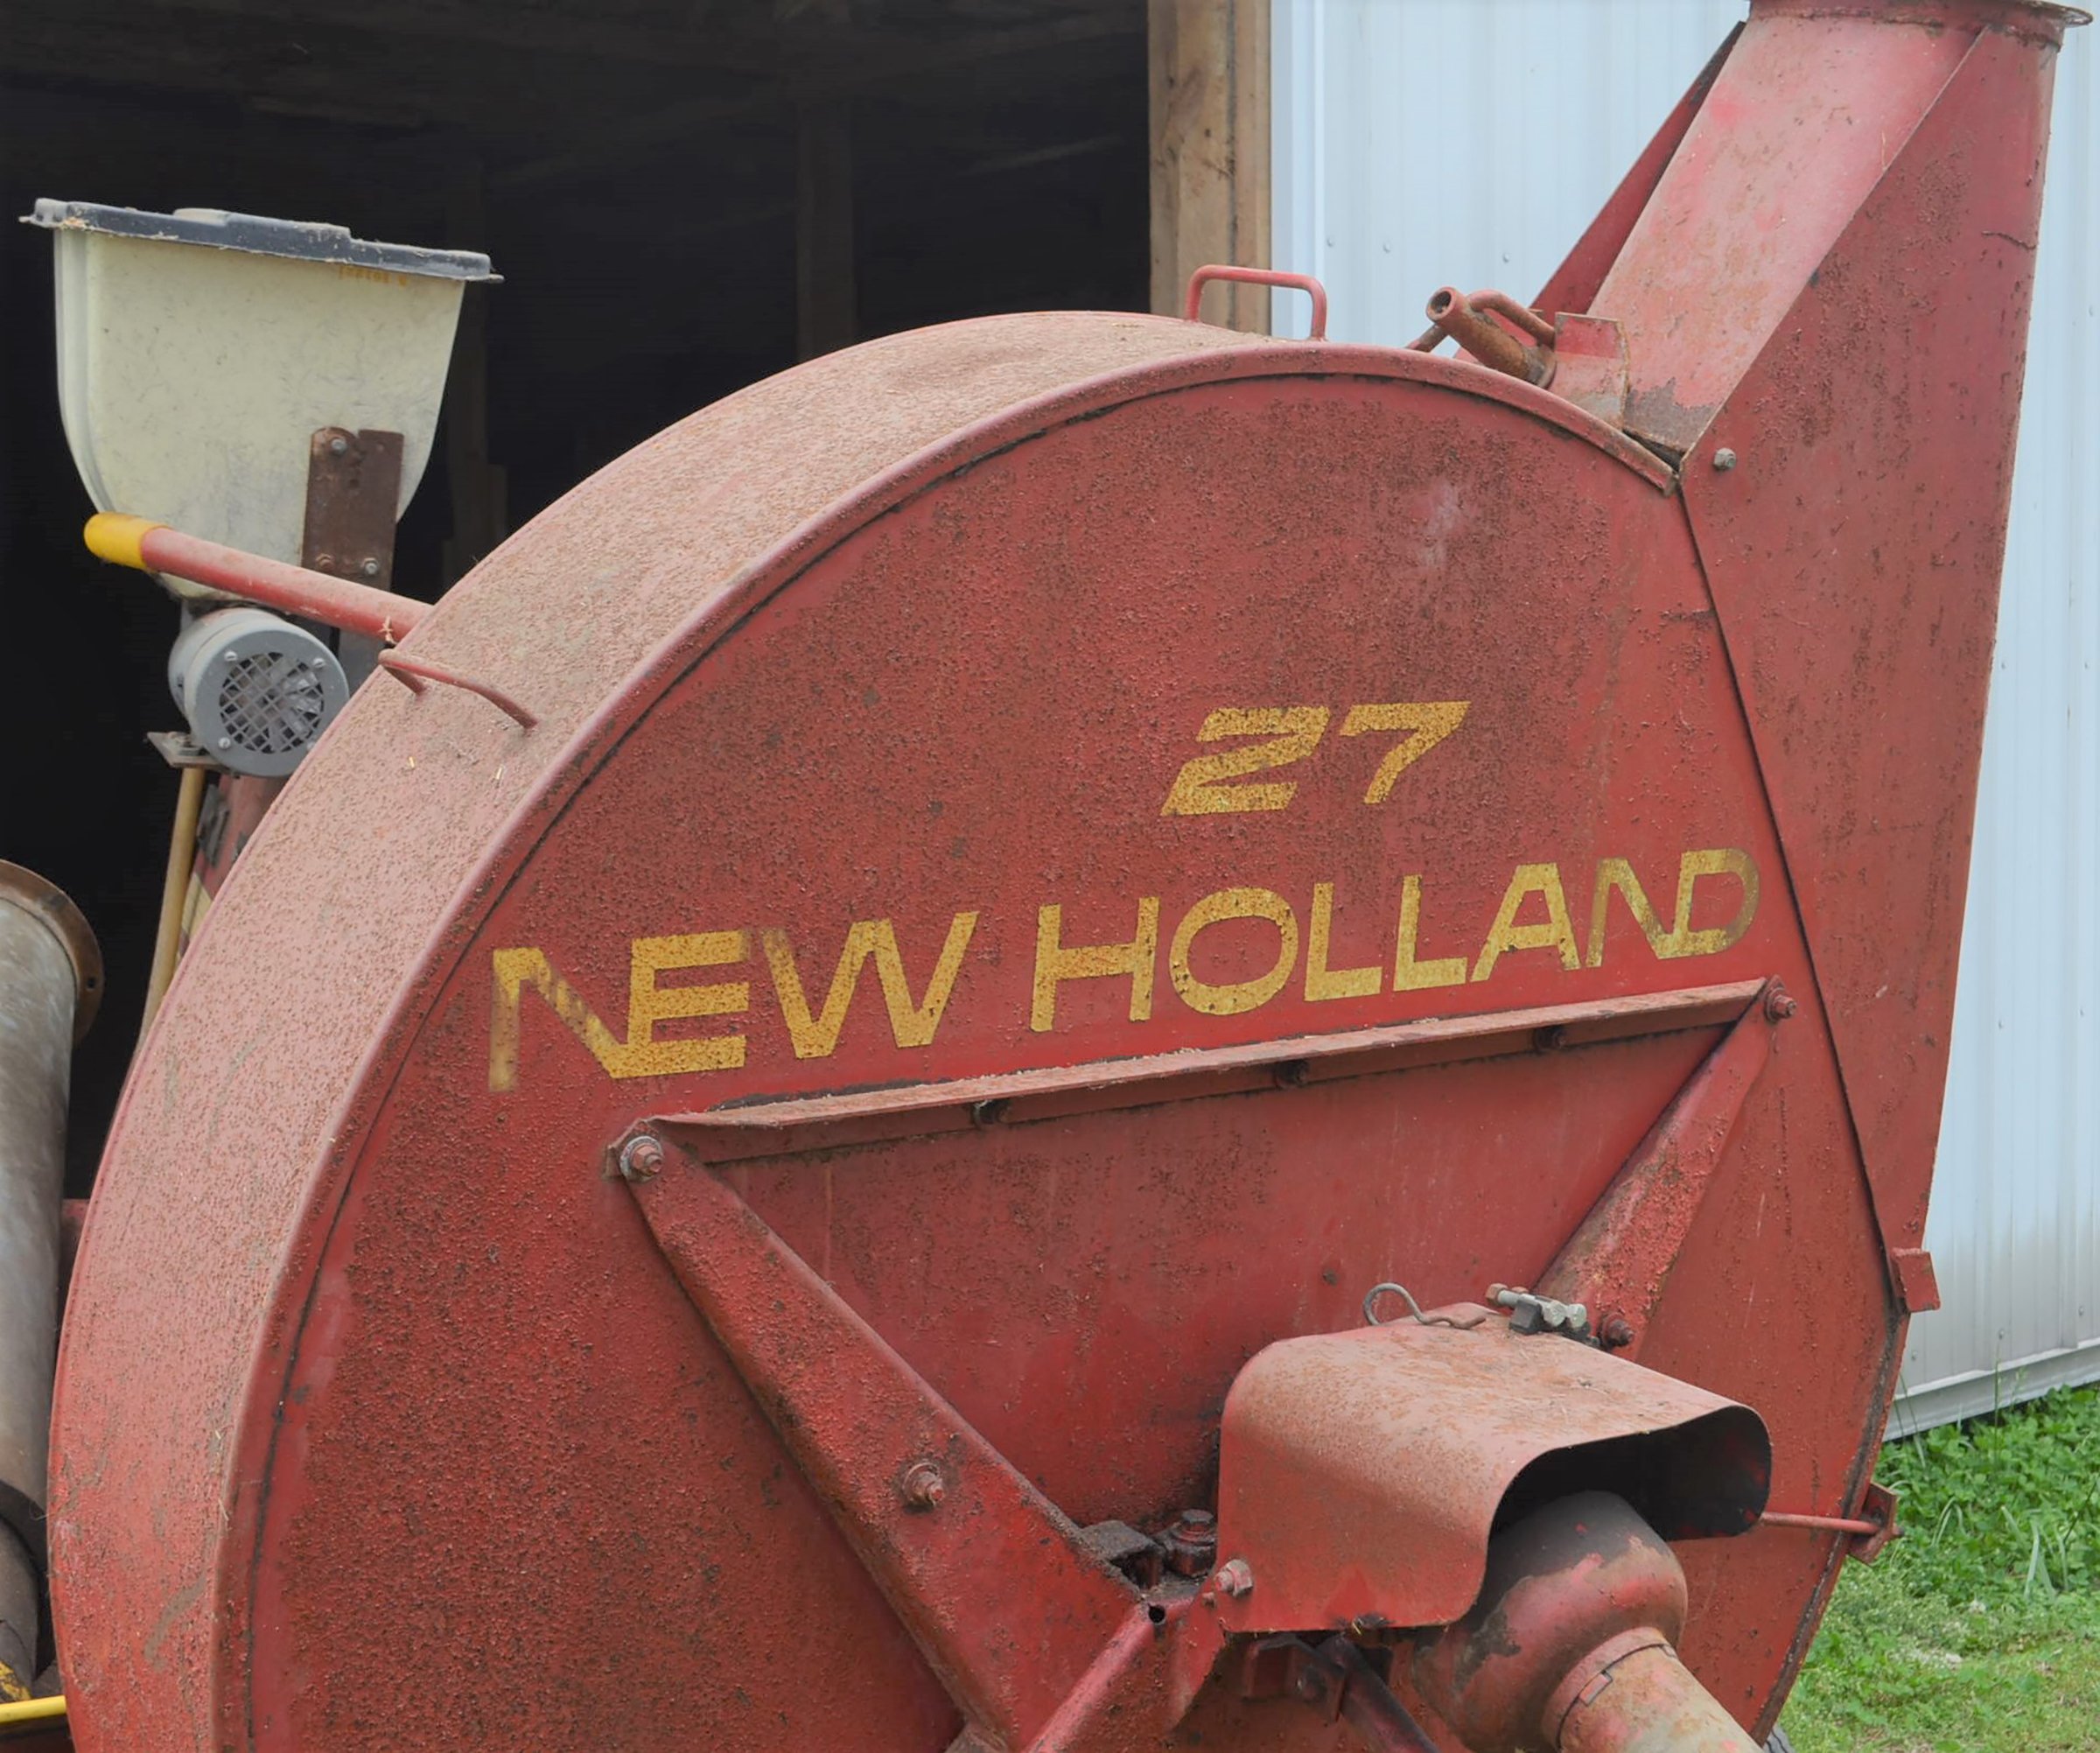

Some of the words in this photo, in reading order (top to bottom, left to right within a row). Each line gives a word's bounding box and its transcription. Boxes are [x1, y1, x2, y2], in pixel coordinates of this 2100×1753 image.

[1161, 700, 1470, 816] 27
[488, 910, 979, 1090] NEW
[1030, 848, 1759, 1033] HOLLAND
